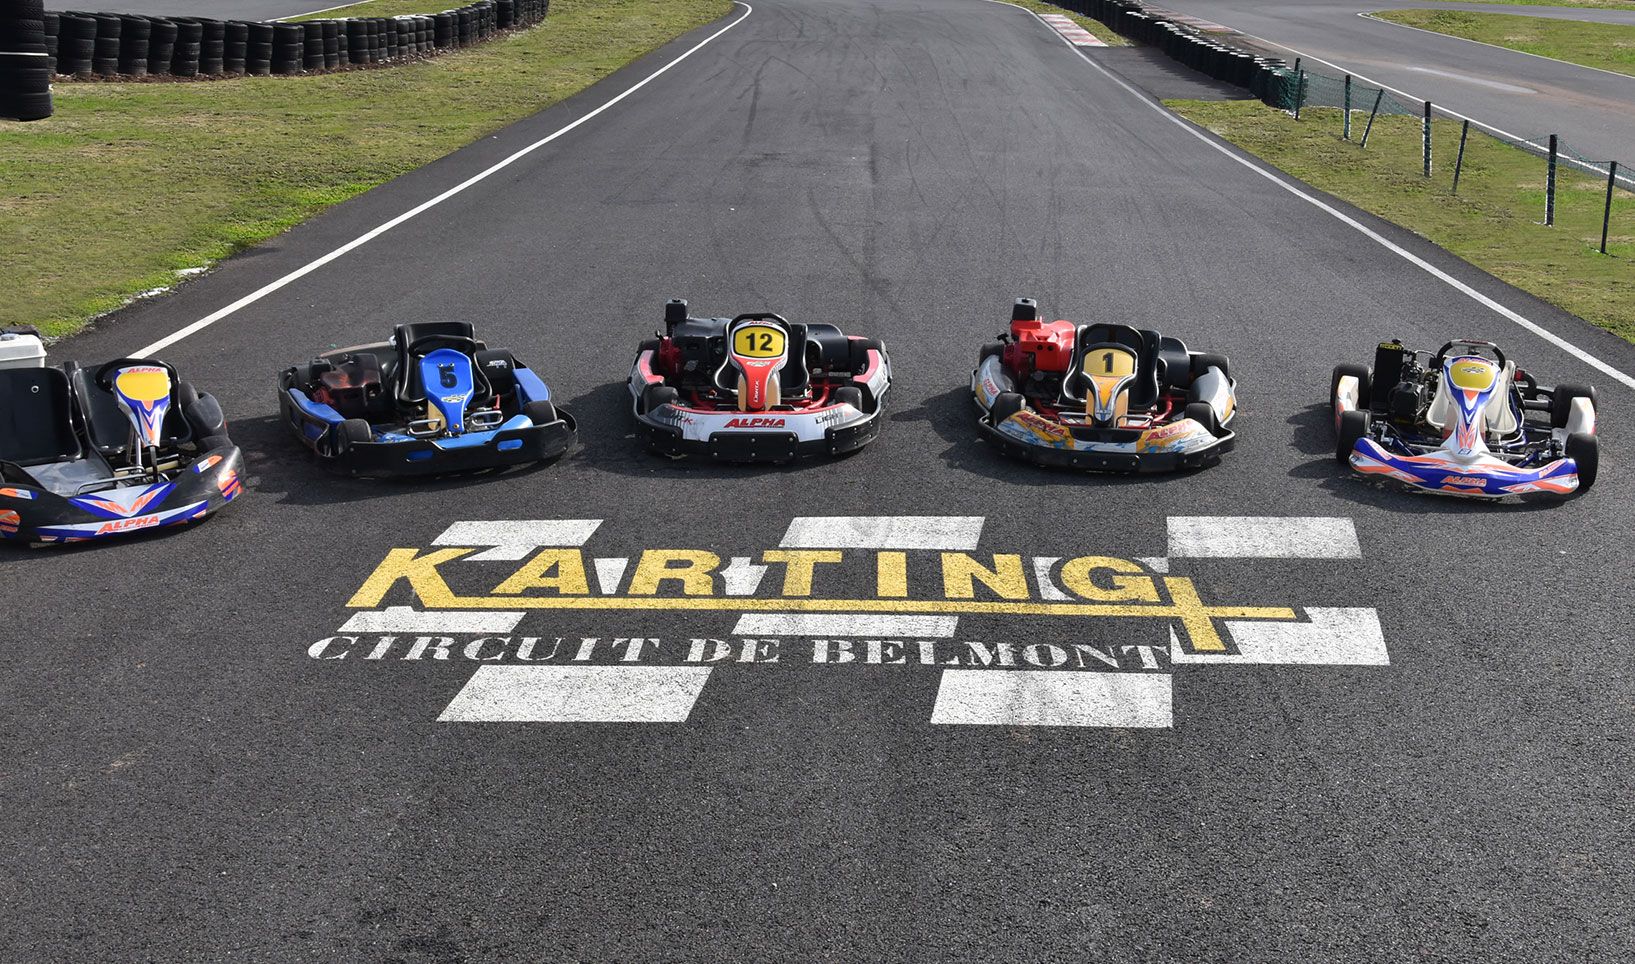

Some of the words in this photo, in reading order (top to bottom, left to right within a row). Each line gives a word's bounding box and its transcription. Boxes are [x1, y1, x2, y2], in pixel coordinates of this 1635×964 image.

[746, 332, 773, 352] 12
[127, 366, 162, 374] ALPHA
[1102, 352, 1114, 373] 1
[438, 364, 458, 389] 5
[723, 417, 786, 429] ALPHA
[1441, 475, 1487, 488] ALPHA
[96, 515, 160, 535] ALPHA
[307, 636, 660, 663] CIRCUIT
[687, 638, 780, 664] DE
[812, 638, 1170, 670] BELMONT
